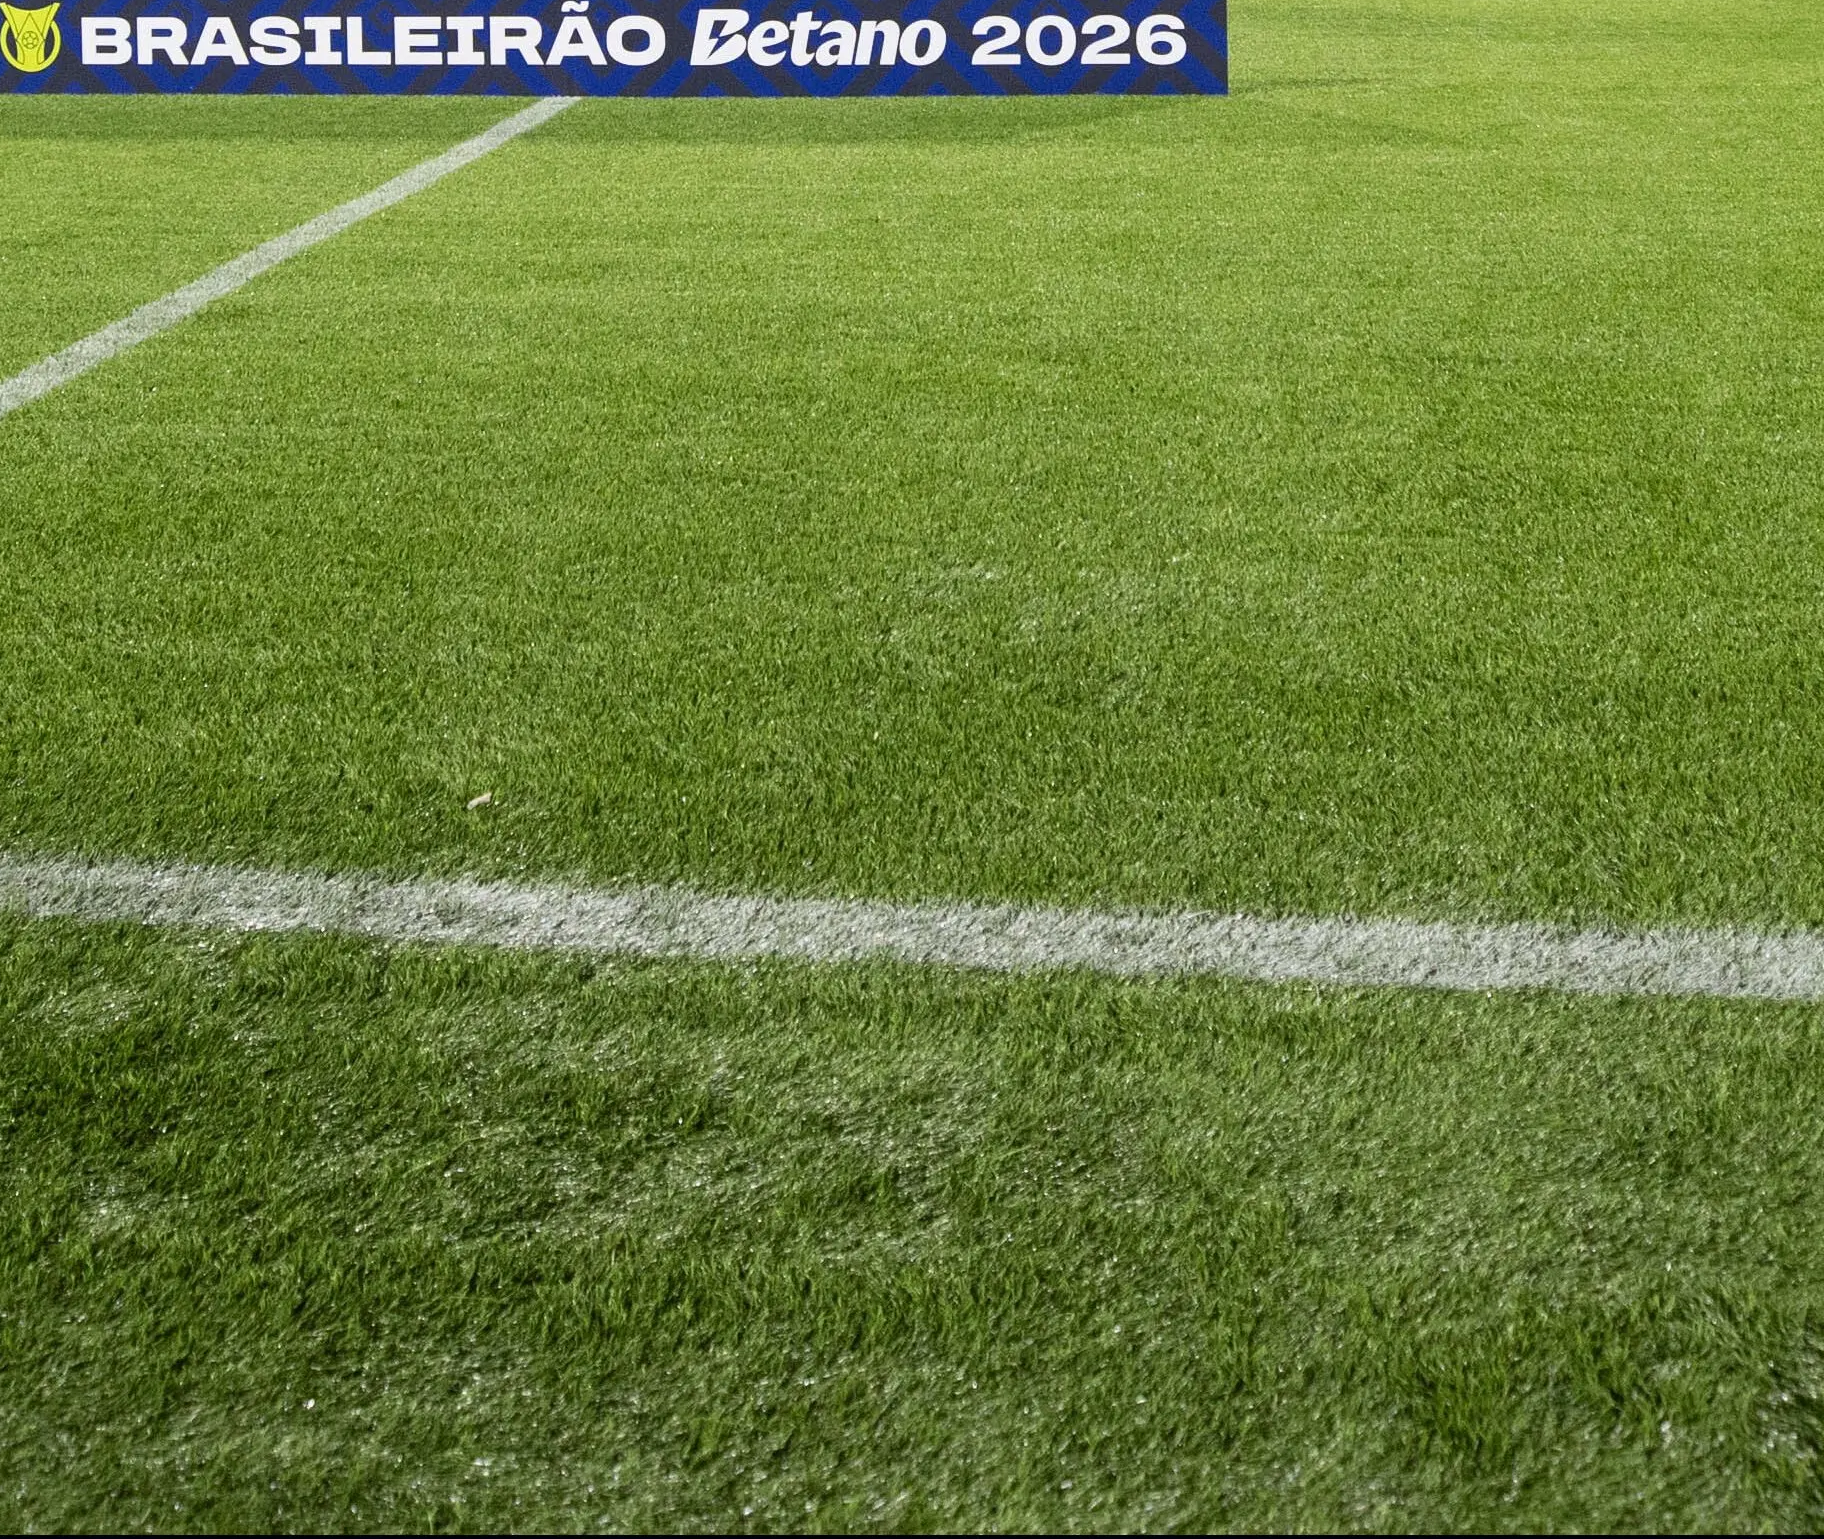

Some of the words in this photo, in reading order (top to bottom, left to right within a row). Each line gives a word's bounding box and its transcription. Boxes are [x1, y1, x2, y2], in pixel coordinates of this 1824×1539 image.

[79, 1, 666, 67] BRASILEIRÃO
[691, 7, 947, 67] Betano
[973, 14, 1188, 65] 2026
